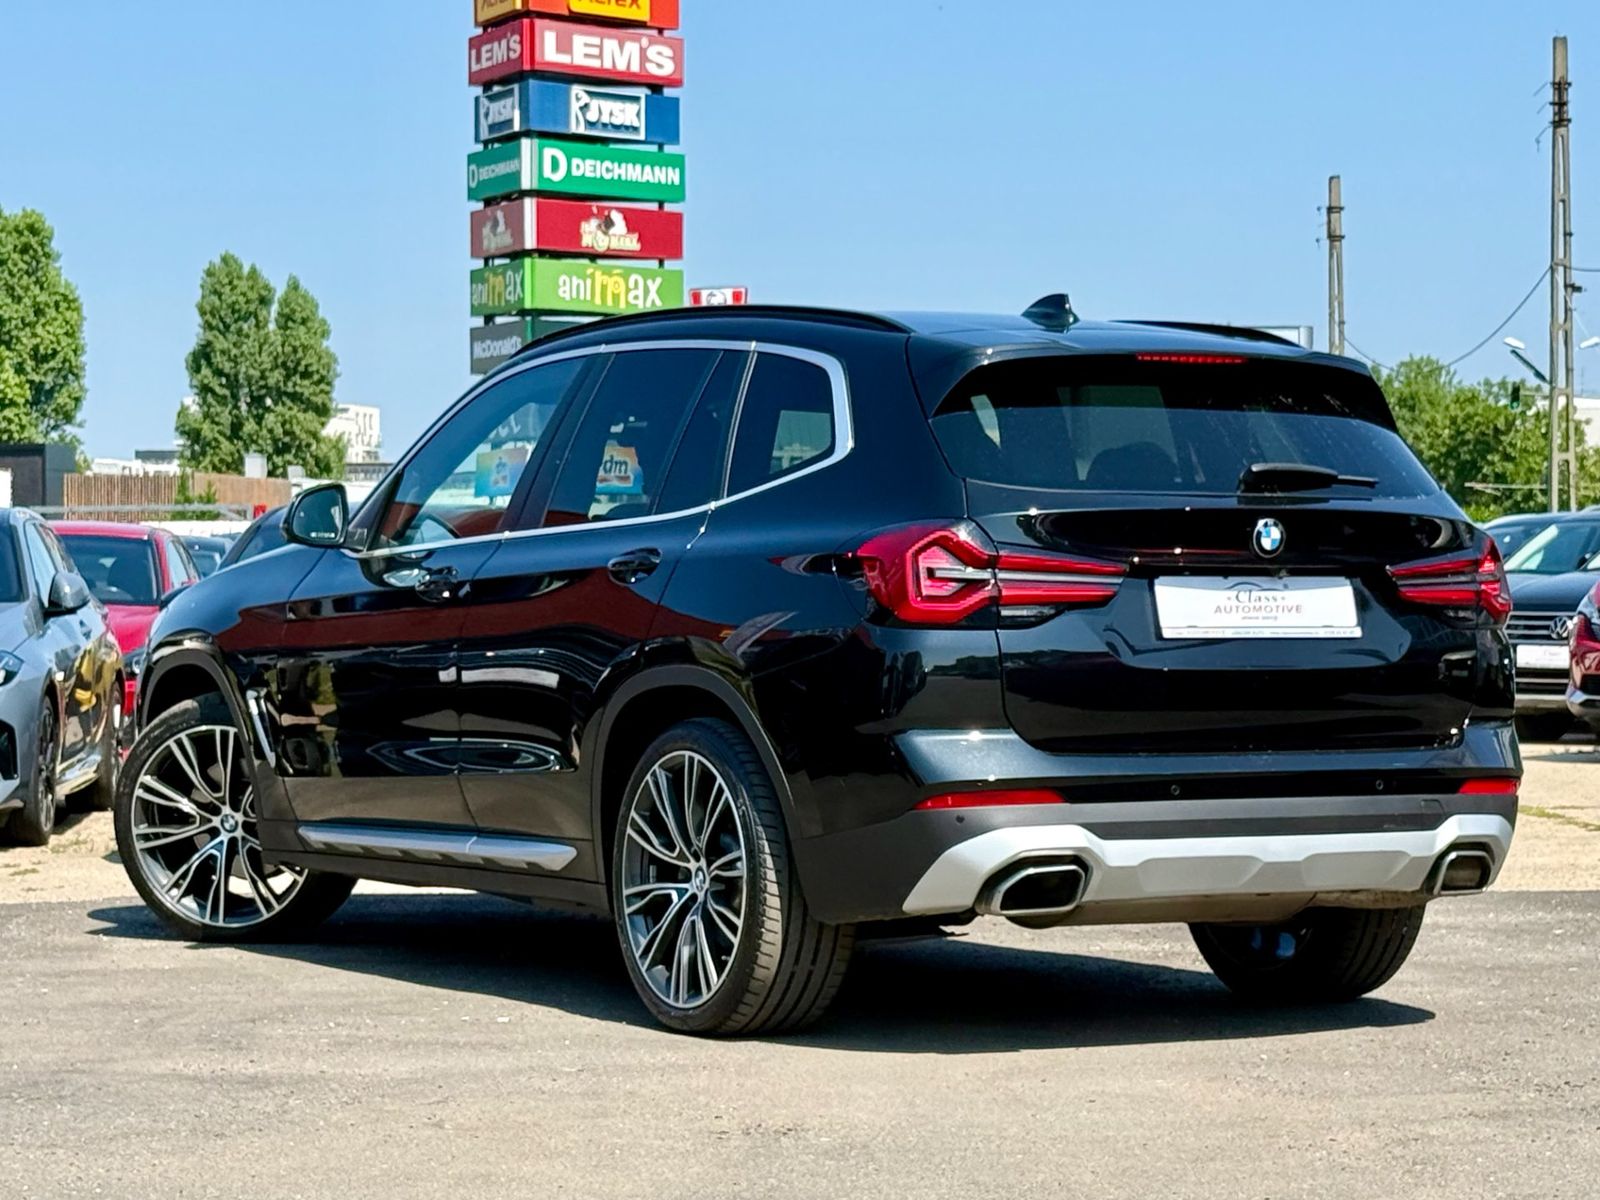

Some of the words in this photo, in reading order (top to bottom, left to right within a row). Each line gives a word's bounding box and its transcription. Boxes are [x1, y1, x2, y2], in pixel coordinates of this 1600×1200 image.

[470, 32, 522, 73] LEM'S
[543, 30, 676, 77] LEM'S
[586, 99, 642, 129] JYSK
[571, 160, 681, 186] DEICHMANN
[558, 268, 663, 309] animax
[1213, 604, 1303, 615] AUTOMOTIVE
[1235, 589, 1279, 604] Class
